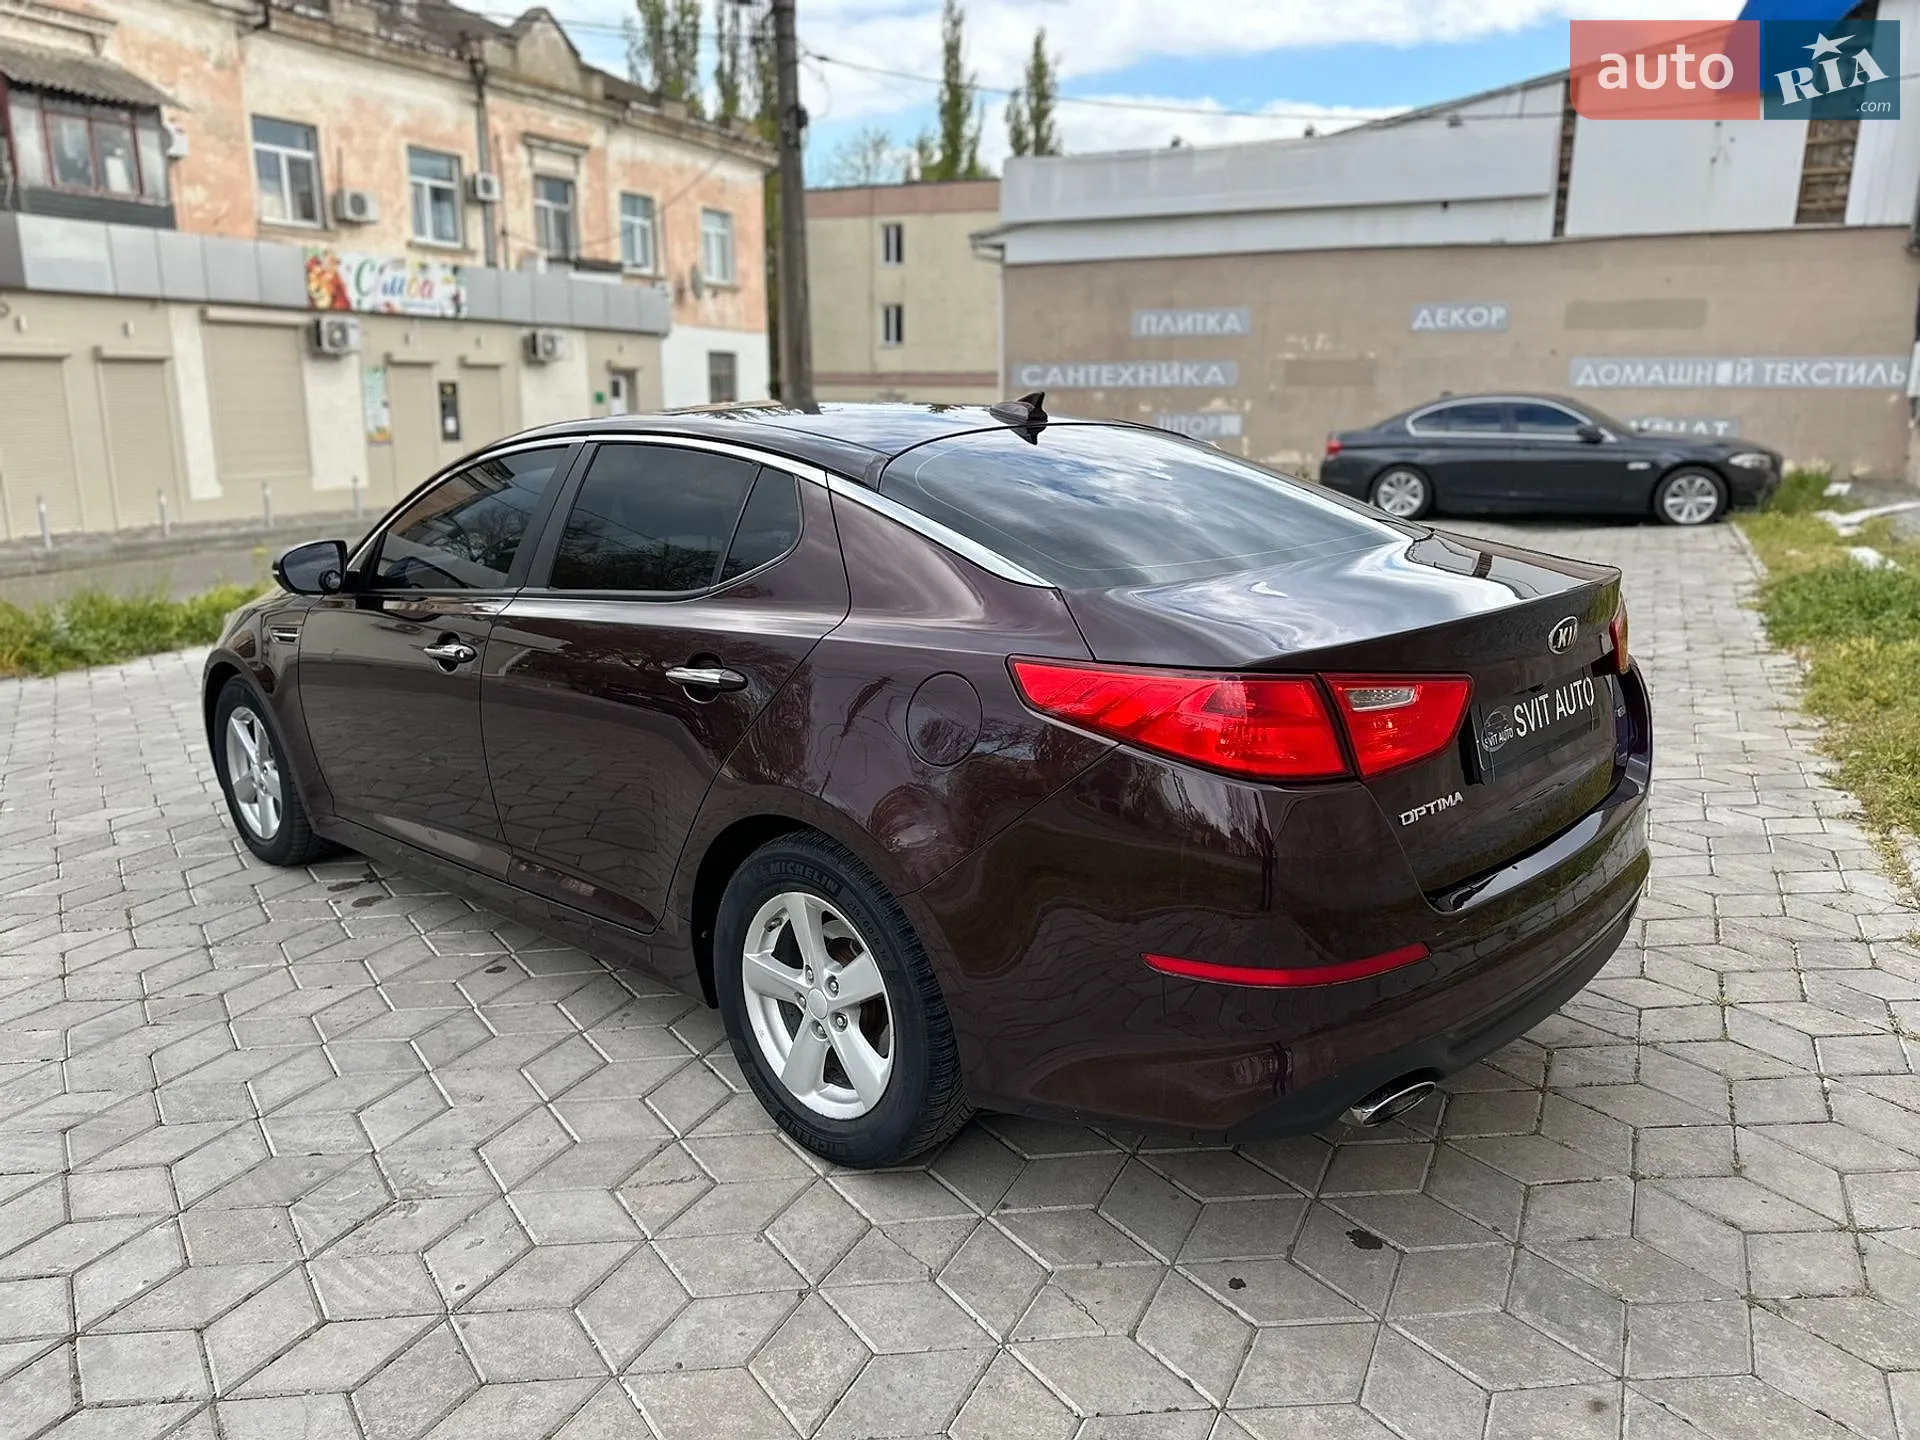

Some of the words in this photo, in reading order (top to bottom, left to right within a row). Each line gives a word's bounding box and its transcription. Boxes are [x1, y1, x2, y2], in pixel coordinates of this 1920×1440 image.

[1140, 311, 1244, 334] ПЛИТКА
[1411, 305, 1506, 331] ДЕКОР
[1575, 359, 1754, 387] ДОМАШНЙ
[1763, 361, 1906, 386] ТЕКСТИЛЬ
[1513, 693, 1549, 738] SVIT
[1555, 676, 1595, 721] AUTO
[1400, 791, 1464, 827] OPTIMA
[769, 862, 840, 896] MICHELIN
